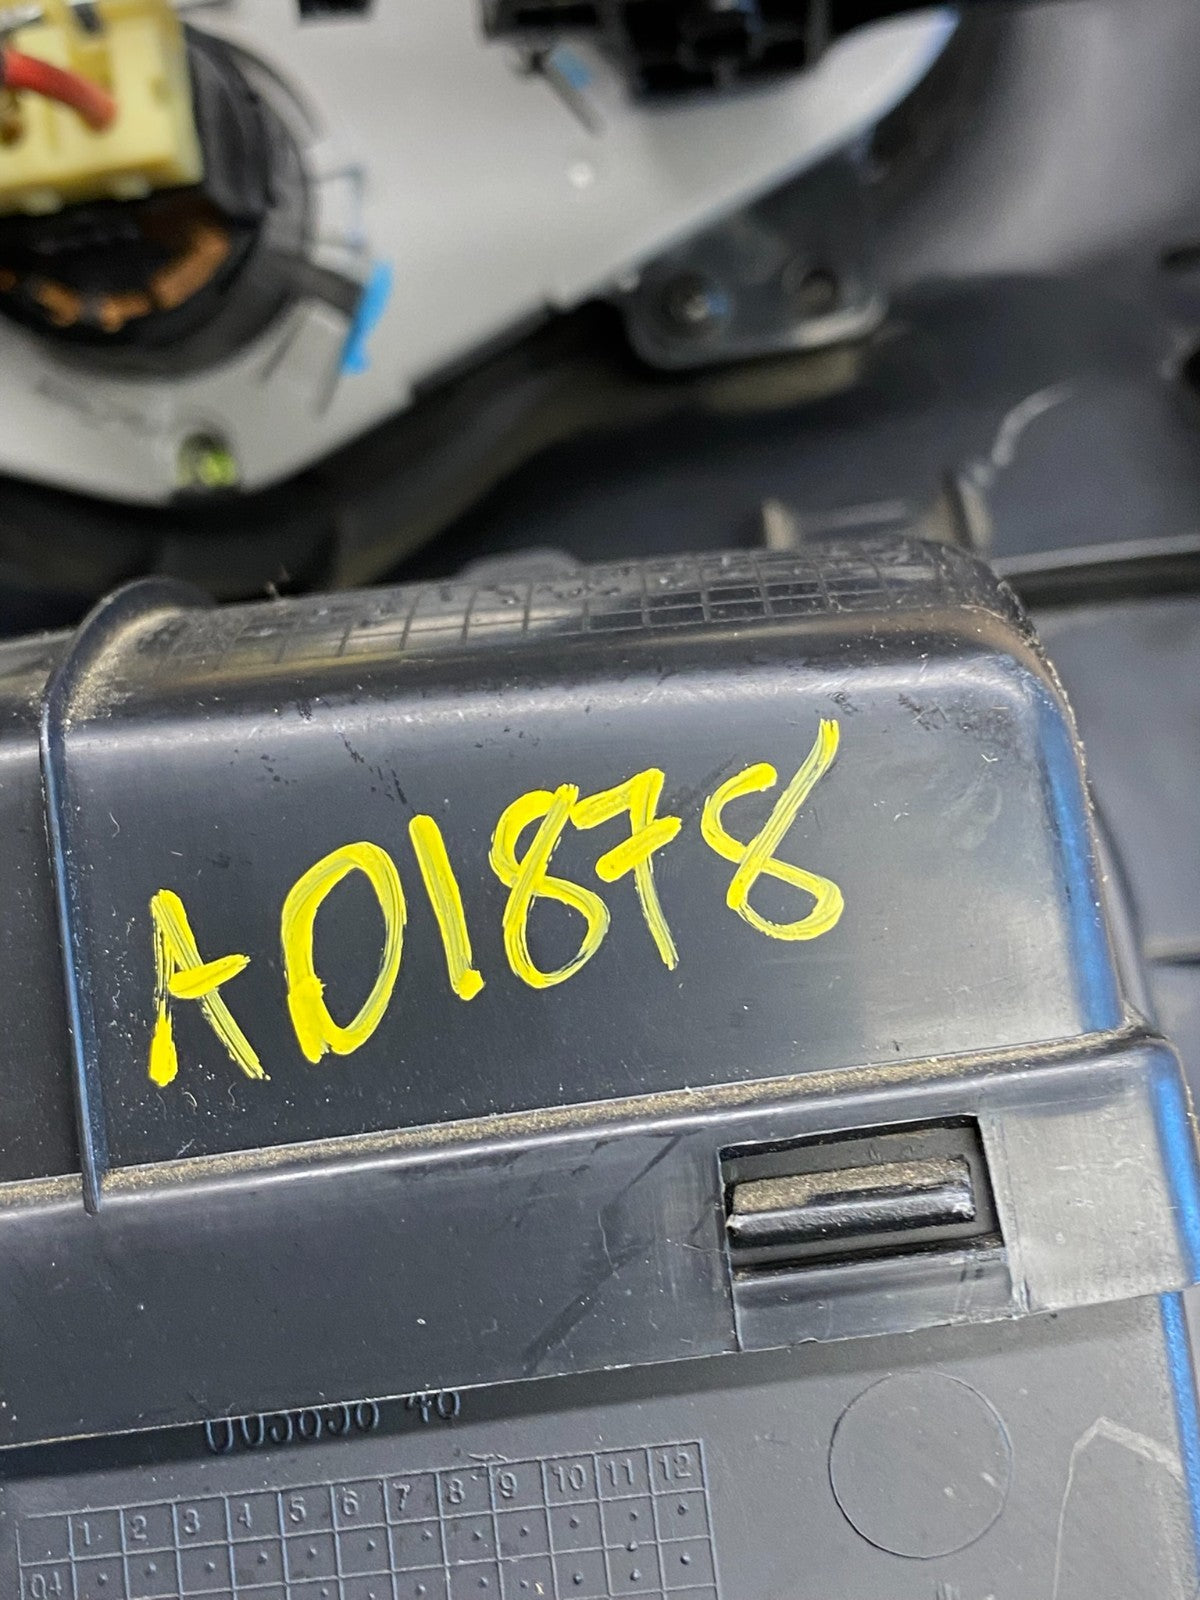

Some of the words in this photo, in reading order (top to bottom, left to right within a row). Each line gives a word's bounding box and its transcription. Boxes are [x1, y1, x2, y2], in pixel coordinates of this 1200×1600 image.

[149, 719, 844, 1087] A01878
[81, 1520, 92, 1546] 1
[130, 1514, 148, 1541] 2
[184, 1508, 201, 1535] 3
[238, 1502, 252, 1529] 4
[288, 1495, 307, 1523] 5
[342, 1488, 360, 1517] 6
[393, 1482, 411, 1510] 7
[449, 1478, 466, 1505] 8
[499, 1471, 518, 1499] 9
[552, 1463, 587, 1493] 10
[605, 1457, 635, 1486] 11
[659, 1451, 693, 1481] 12
